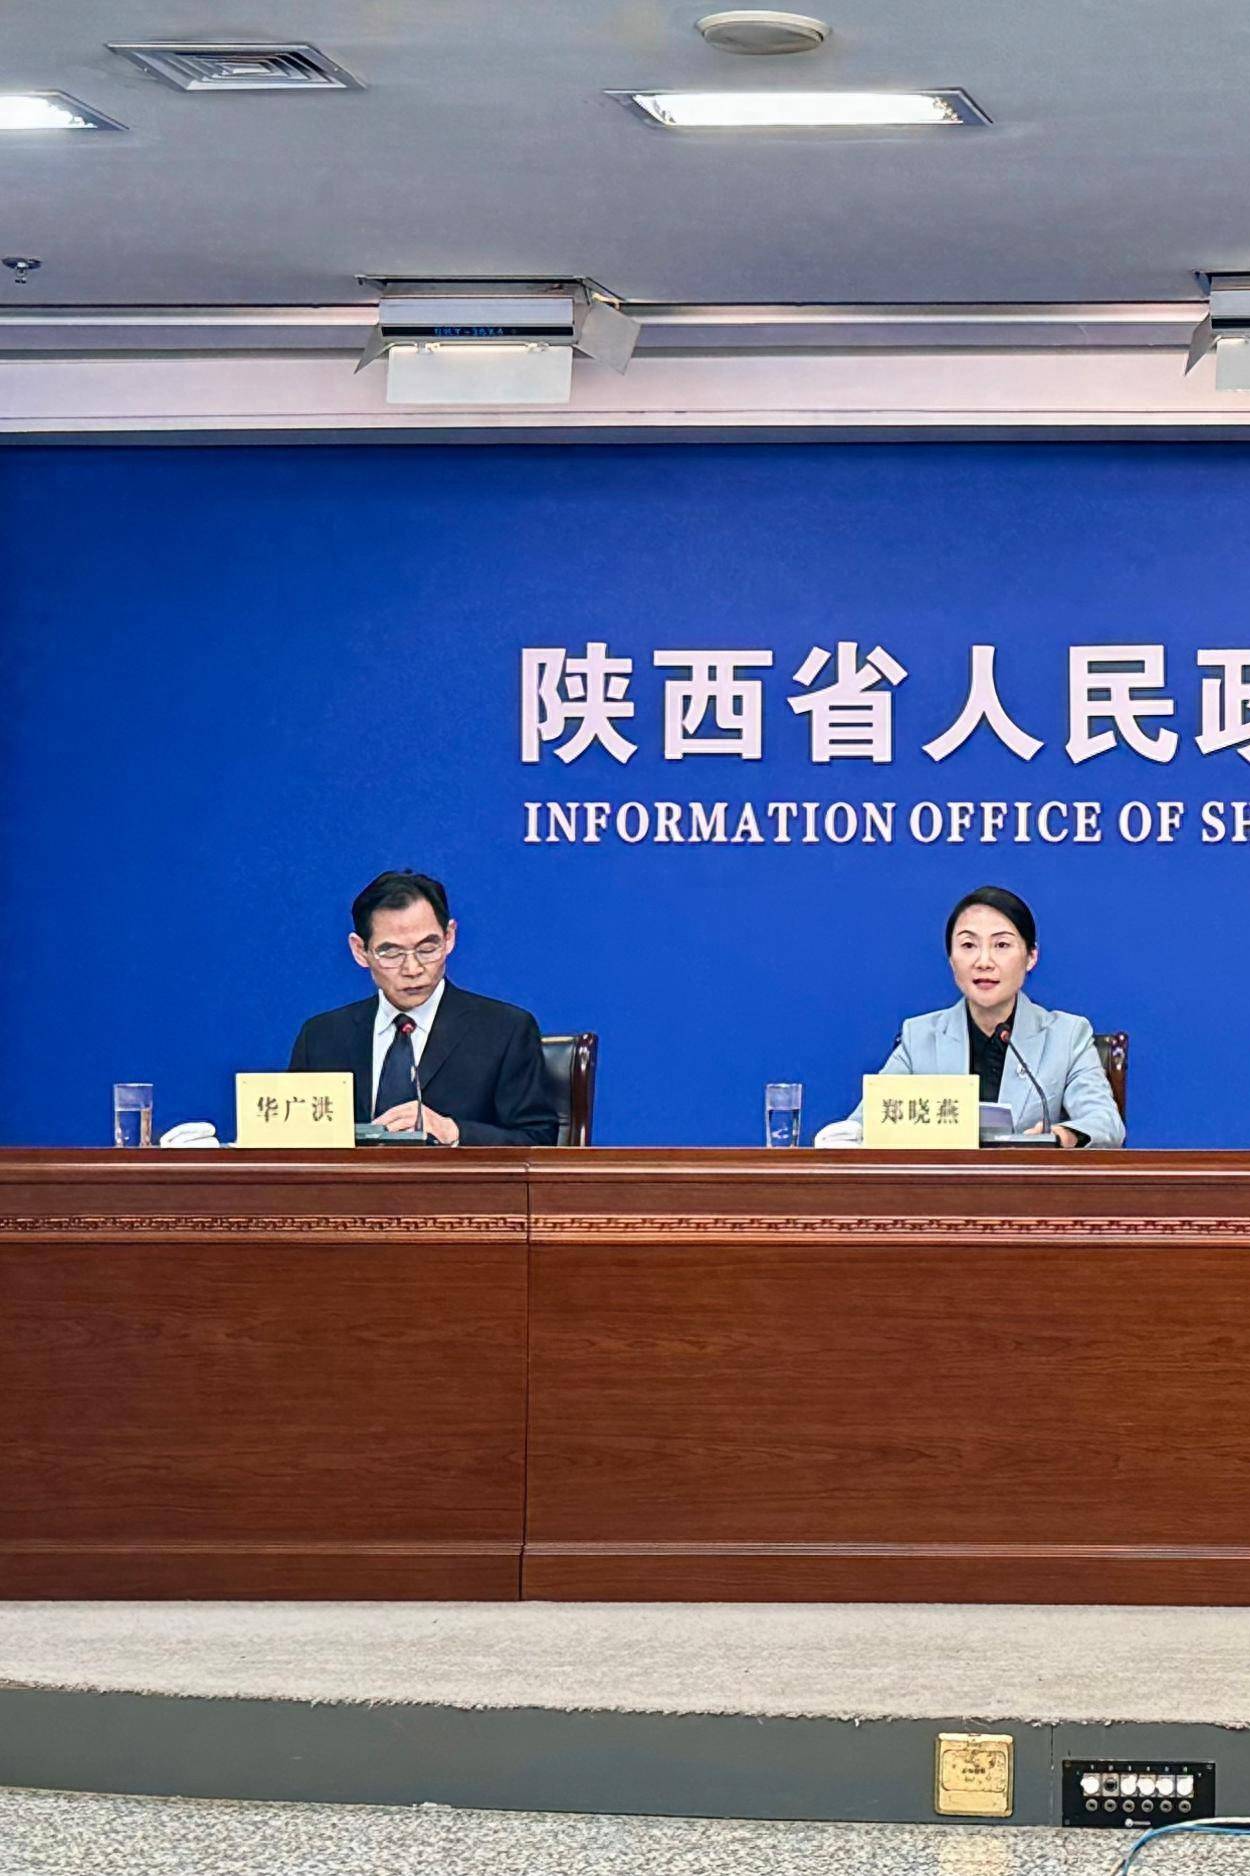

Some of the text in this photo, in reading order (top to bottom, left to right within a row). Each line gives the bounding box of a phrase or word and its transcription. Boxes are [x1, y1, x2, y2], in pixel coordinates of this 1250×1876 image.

[524, 801, 896, 843] INFORMATION
[909, 800, 1102, 843] OFFICE
[1119, 800, 1184, 843] OF
[256, 1096, 334, 1123] 华广洪
[881, 1098, 960, 1124] 郑晓燕
